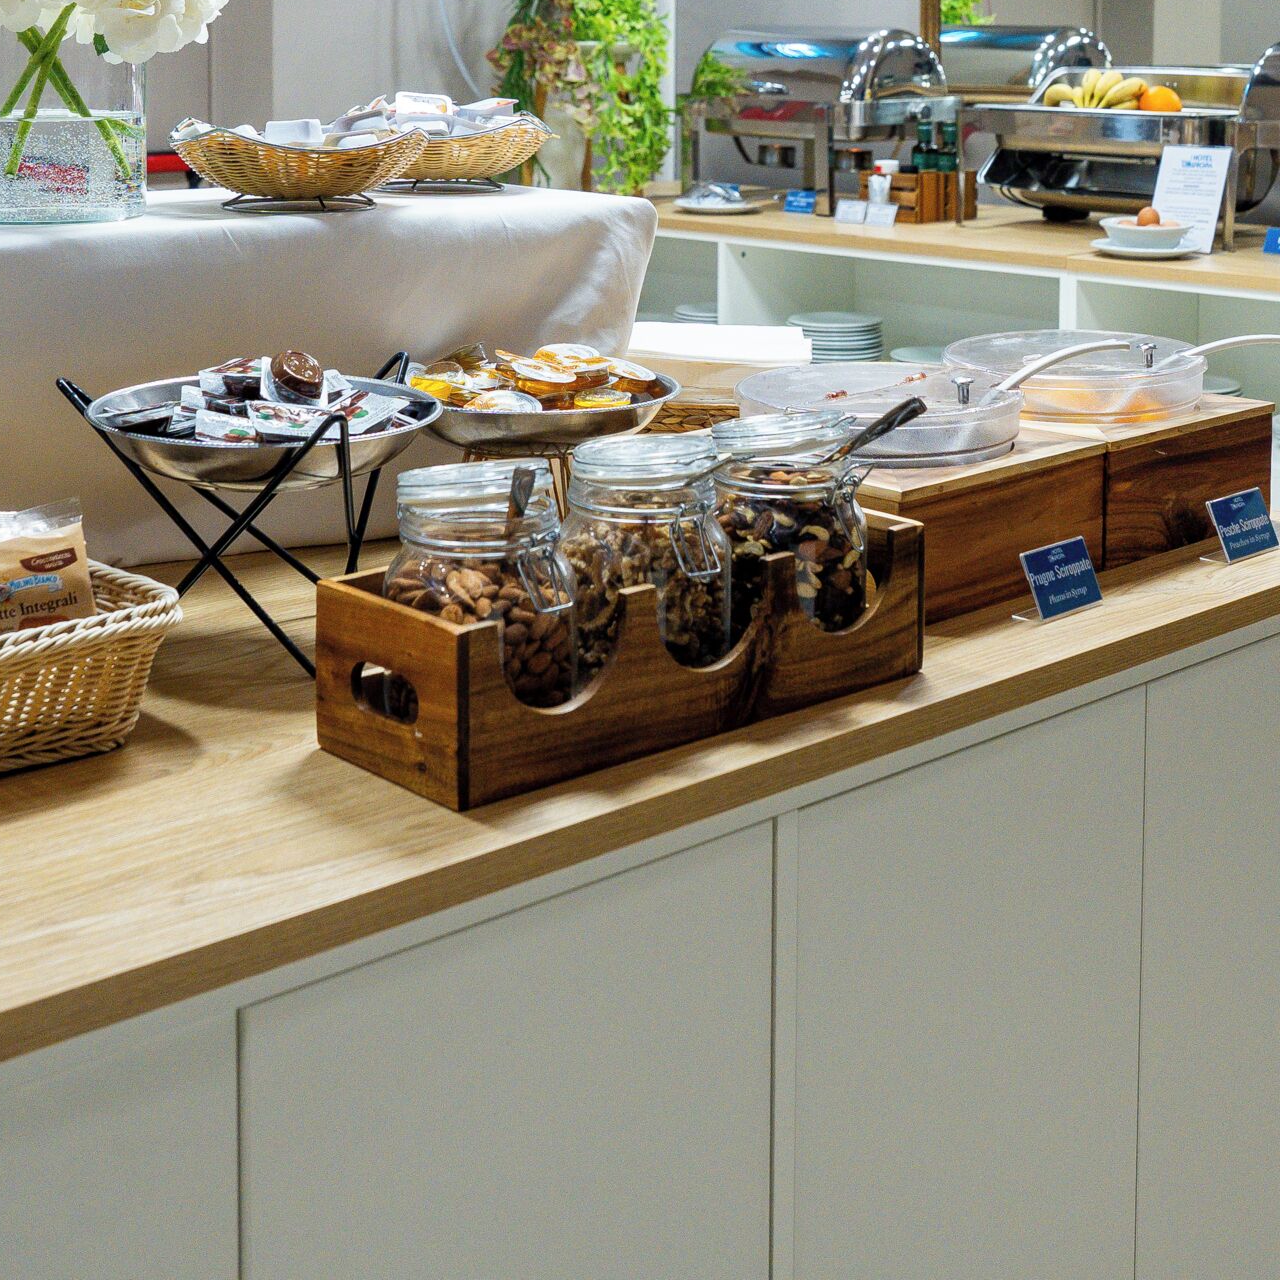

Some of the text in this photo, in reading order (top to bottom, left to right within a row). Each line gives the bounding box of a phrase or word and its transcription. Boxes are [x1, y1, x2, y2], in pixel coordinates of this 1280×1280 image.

[1219, 513, 1270, 538] Pesche Sciroppate
[1029, 558, 1092, 587] Prugne Sciroppate
[20, 591, 79, 617] Integrali
